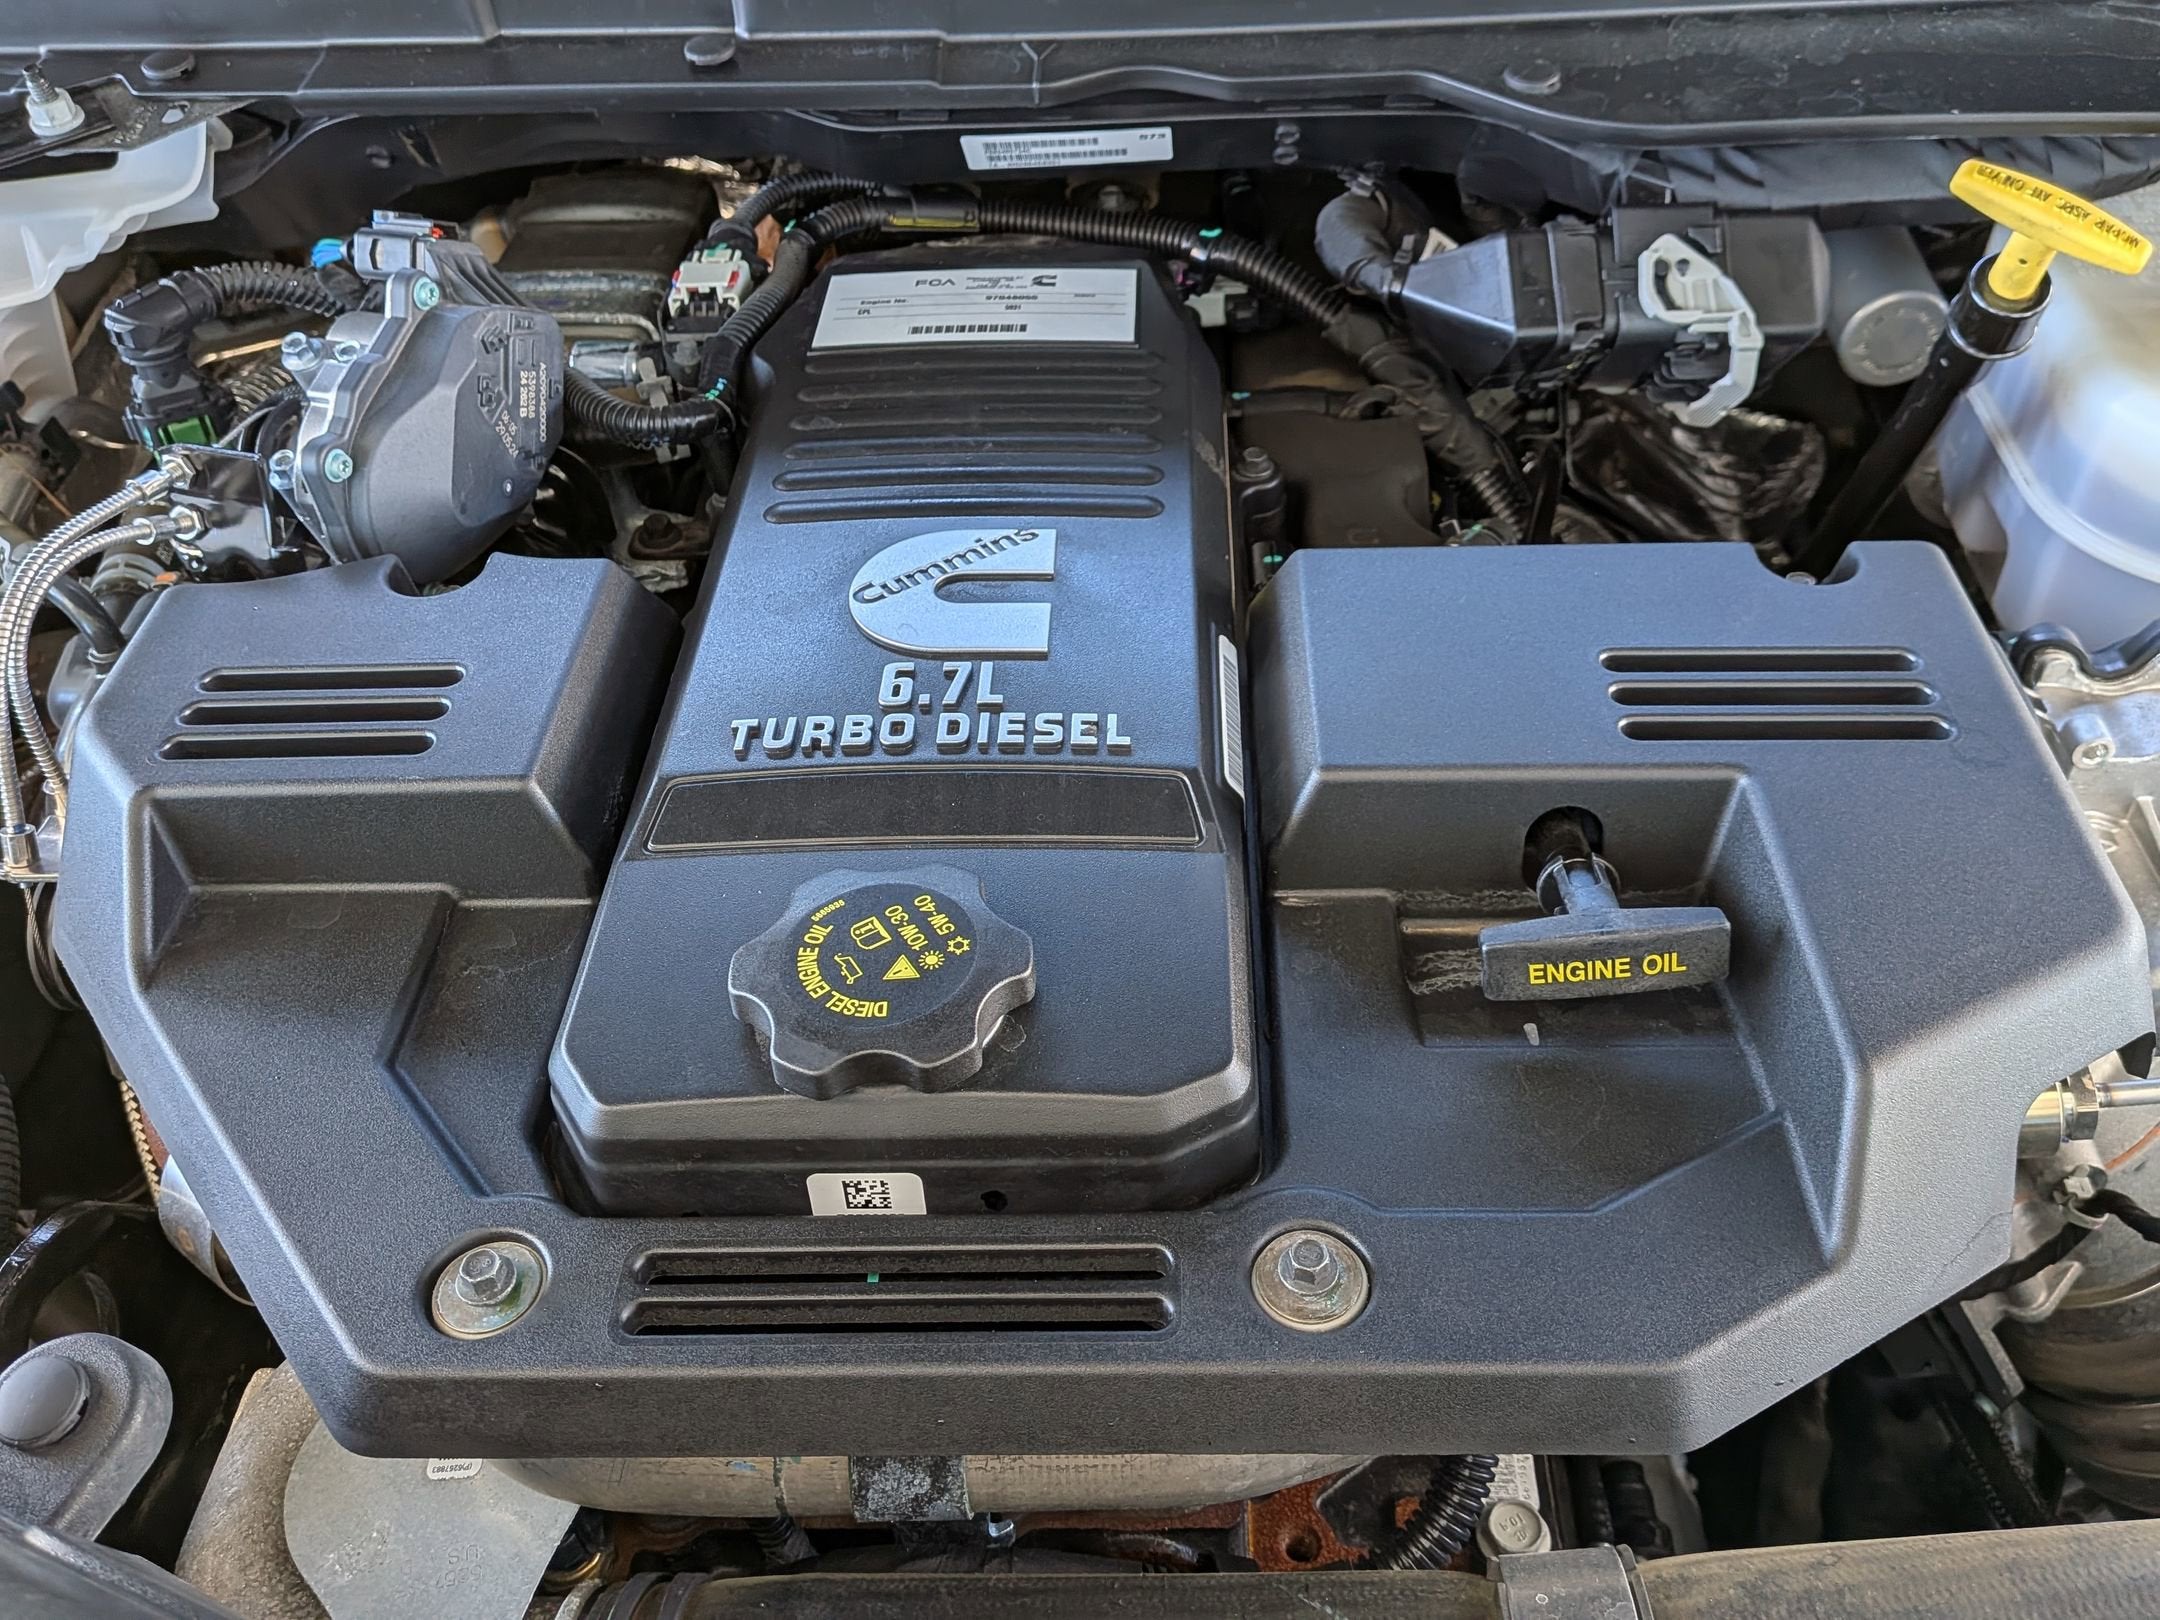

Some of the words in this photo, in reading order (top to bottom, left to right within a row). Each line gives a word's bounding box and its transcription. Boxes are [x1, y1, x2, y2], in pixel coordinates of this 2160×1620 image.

[915, 278, 956, 288] FCA
[854, 527, 1040, 603] Cummins
[878, 661, 1004, 712] 6.7L
[730, 712, 917, 760] TURBO
[936, 712, 1132, 758] DIESEL
[803, 922, 834, 945] OIL
[885, 904, 929, 952] 10W-30
[914, 894, 956, 937] 5W-40
[797, 946, 832, 999] ENGINE
[1528, 956, 1632, 985] ENGINE
[1642, 952, 1688, 976] OIL
[825, 990, 889, 1018] DIESEL
